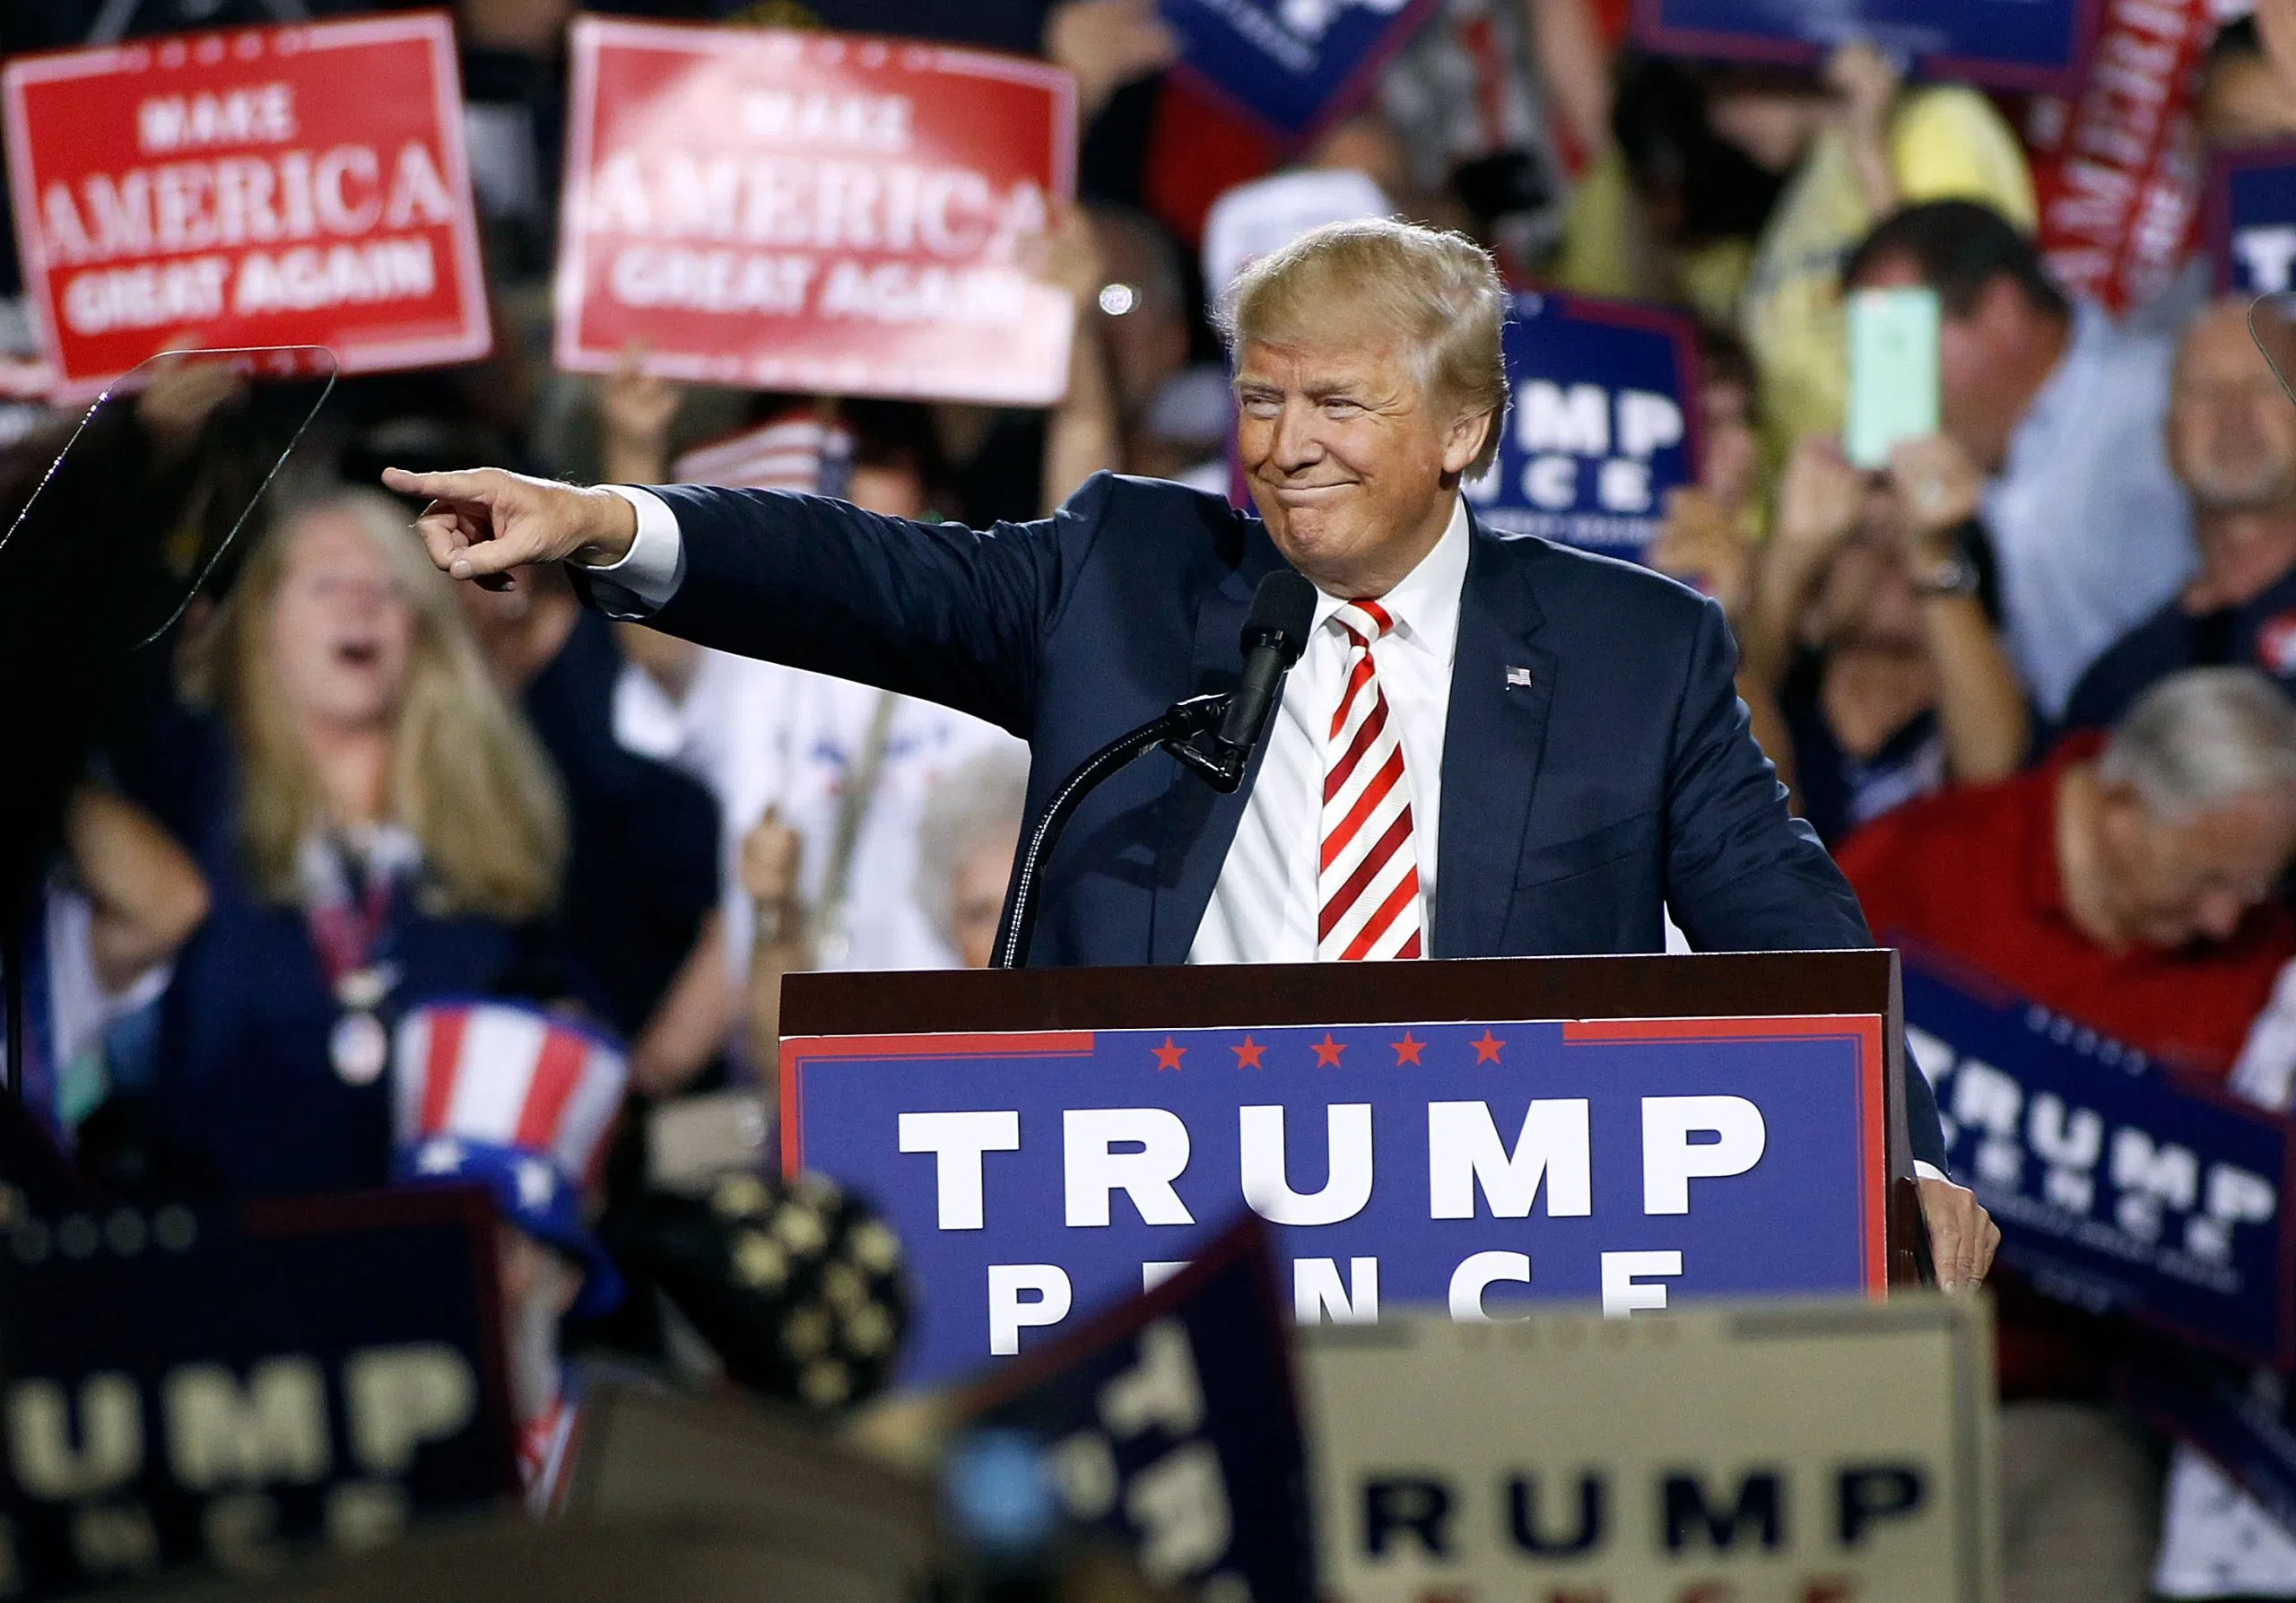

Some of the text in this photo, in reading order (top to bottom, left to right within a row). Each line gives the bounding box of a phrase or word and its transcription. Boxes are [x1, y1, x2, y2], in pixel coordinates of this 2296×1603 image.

[138, 83, 296, 152] MAKE
[45, 142, 450, 267] AMERICA
[586, 151, 1049, 260] AMERICA
[64, 238, 436, 335] GREAT AGAIN
[611, 249, 816, 316] GREAT
[899, 1094, 1767, 1230] TRUMP
[987, 1250, 1683, 1356] PNCE
[5, 1341, 479, 1502] UMP
[1361, 1462, 1926, 1561] RUMP
